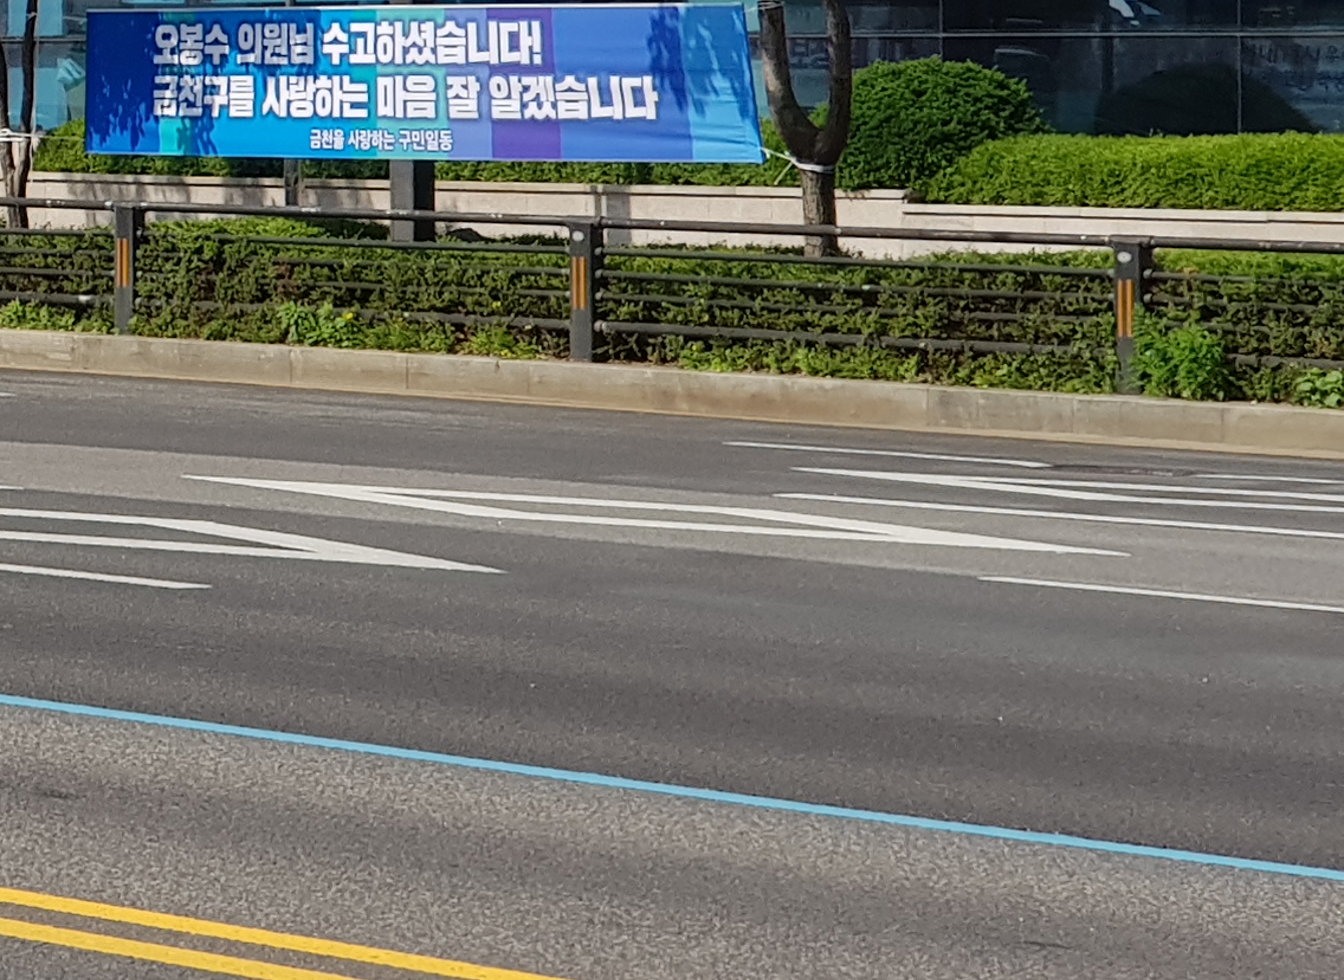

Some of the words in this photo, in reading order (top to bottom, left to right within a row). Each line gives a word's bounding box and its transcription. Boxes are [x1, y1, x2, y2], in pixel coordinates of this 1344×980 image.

[153, 21, 230, 67] 오봉수
[235, 21, 315, 66] 의원님
[321, 19, 543, 67] 수고하셨습니다!
[153, 73, 256, 118] 금천구를
[261, 75, 370, 120] 사랑하는
[376, 74, 437, 120] 마음
[446, 74, 481, 120] 잘
[488, 73, 659, 120] 알겠습니다
[309, 128, 346, 152] 금천을
[347, 128, 396, 152] 사랑하는
[398, 128, 453, 152] 구민일동
